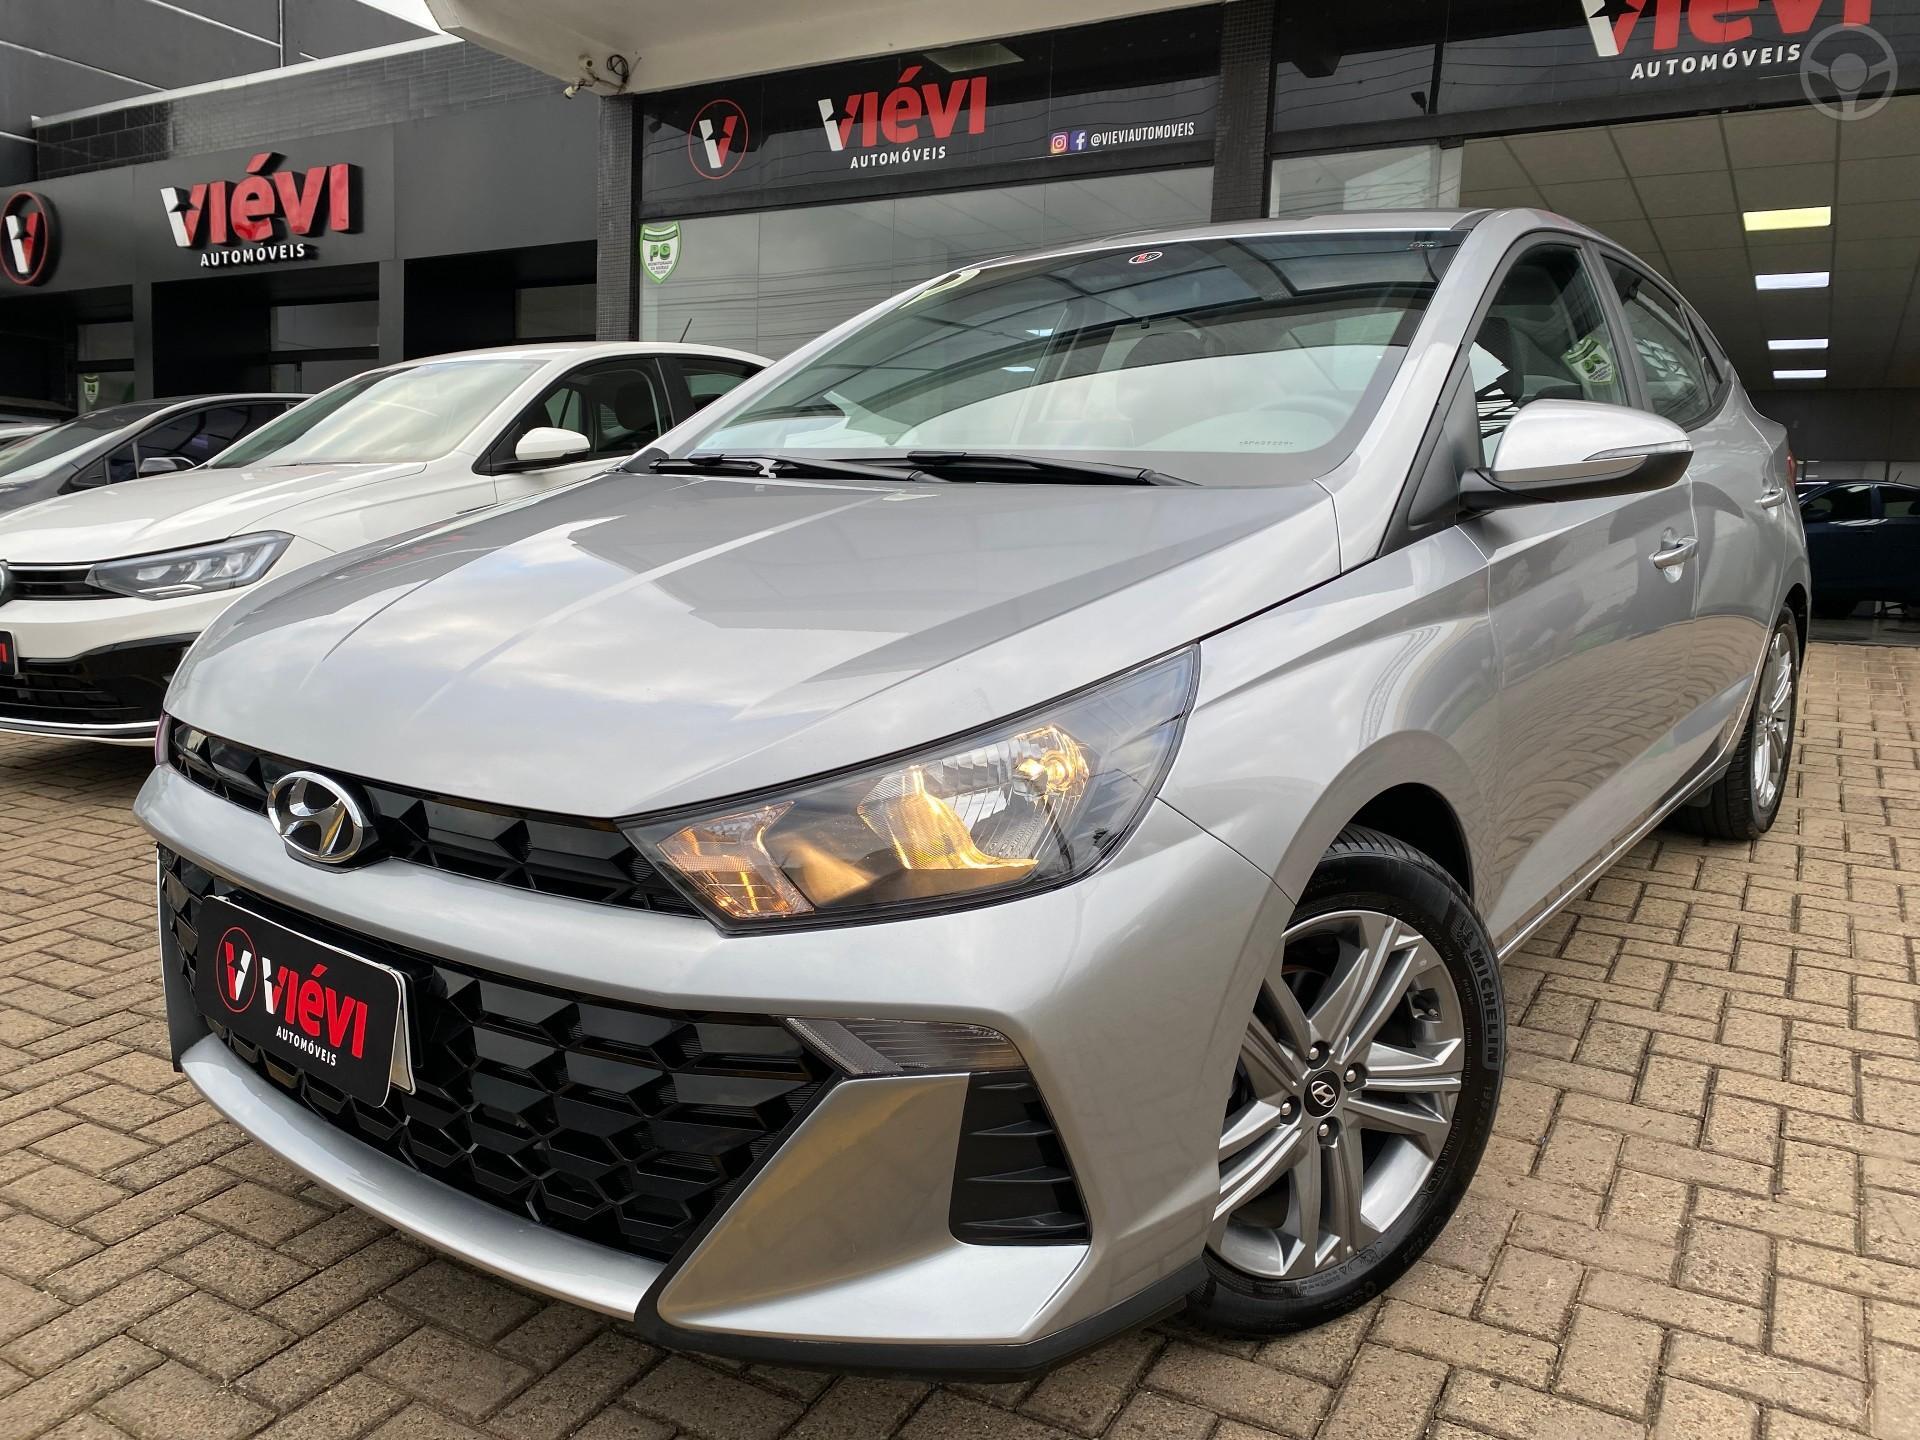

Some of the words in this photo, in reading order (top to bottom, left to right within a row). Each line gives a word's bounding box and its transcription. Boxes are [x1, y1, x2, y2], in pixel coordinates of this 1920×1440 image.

[1630, 43, 1801, 80] AUTOMÓVEIS
[1090, 121, 1195, 147] @VIEVIAUTOMOVEIS
[850, 145, 947, 169] AUTOMÓVEIS
[200, 241, 305, 267] AUTOMÓVEIS
[1469, 949, 1499, 1063] MICHELIN
[275, 1025, 337, 1067] AUTOMÓVEIS
